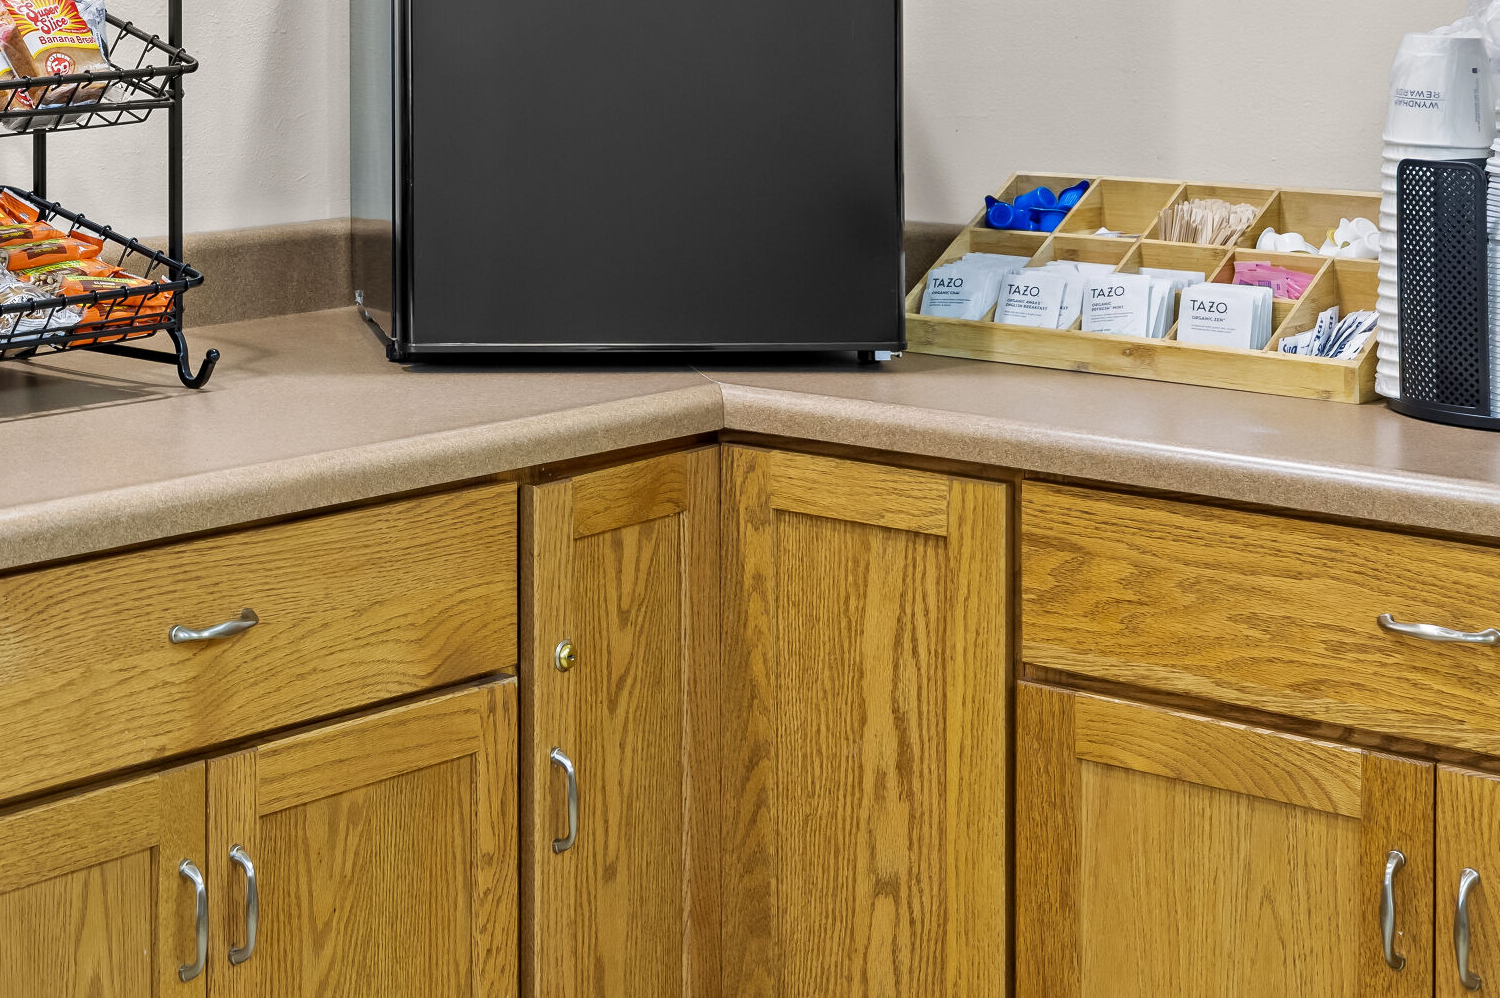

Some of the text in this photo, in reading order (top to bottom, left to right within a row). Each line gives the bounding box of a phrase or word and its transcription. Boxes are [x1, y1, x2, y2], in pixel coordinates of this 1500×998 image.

[16, 1, 60, 27] Super
[41, 16, 68, 35] Slice
[38, 35, 76, 45] Banana
[932, 277, 964, 289] TAZO
[1007, 283, 1040, 298] TAZO
[1091, 286, 1125, 299] TAZO
[1190, 299, 1228, 314] TAZO
